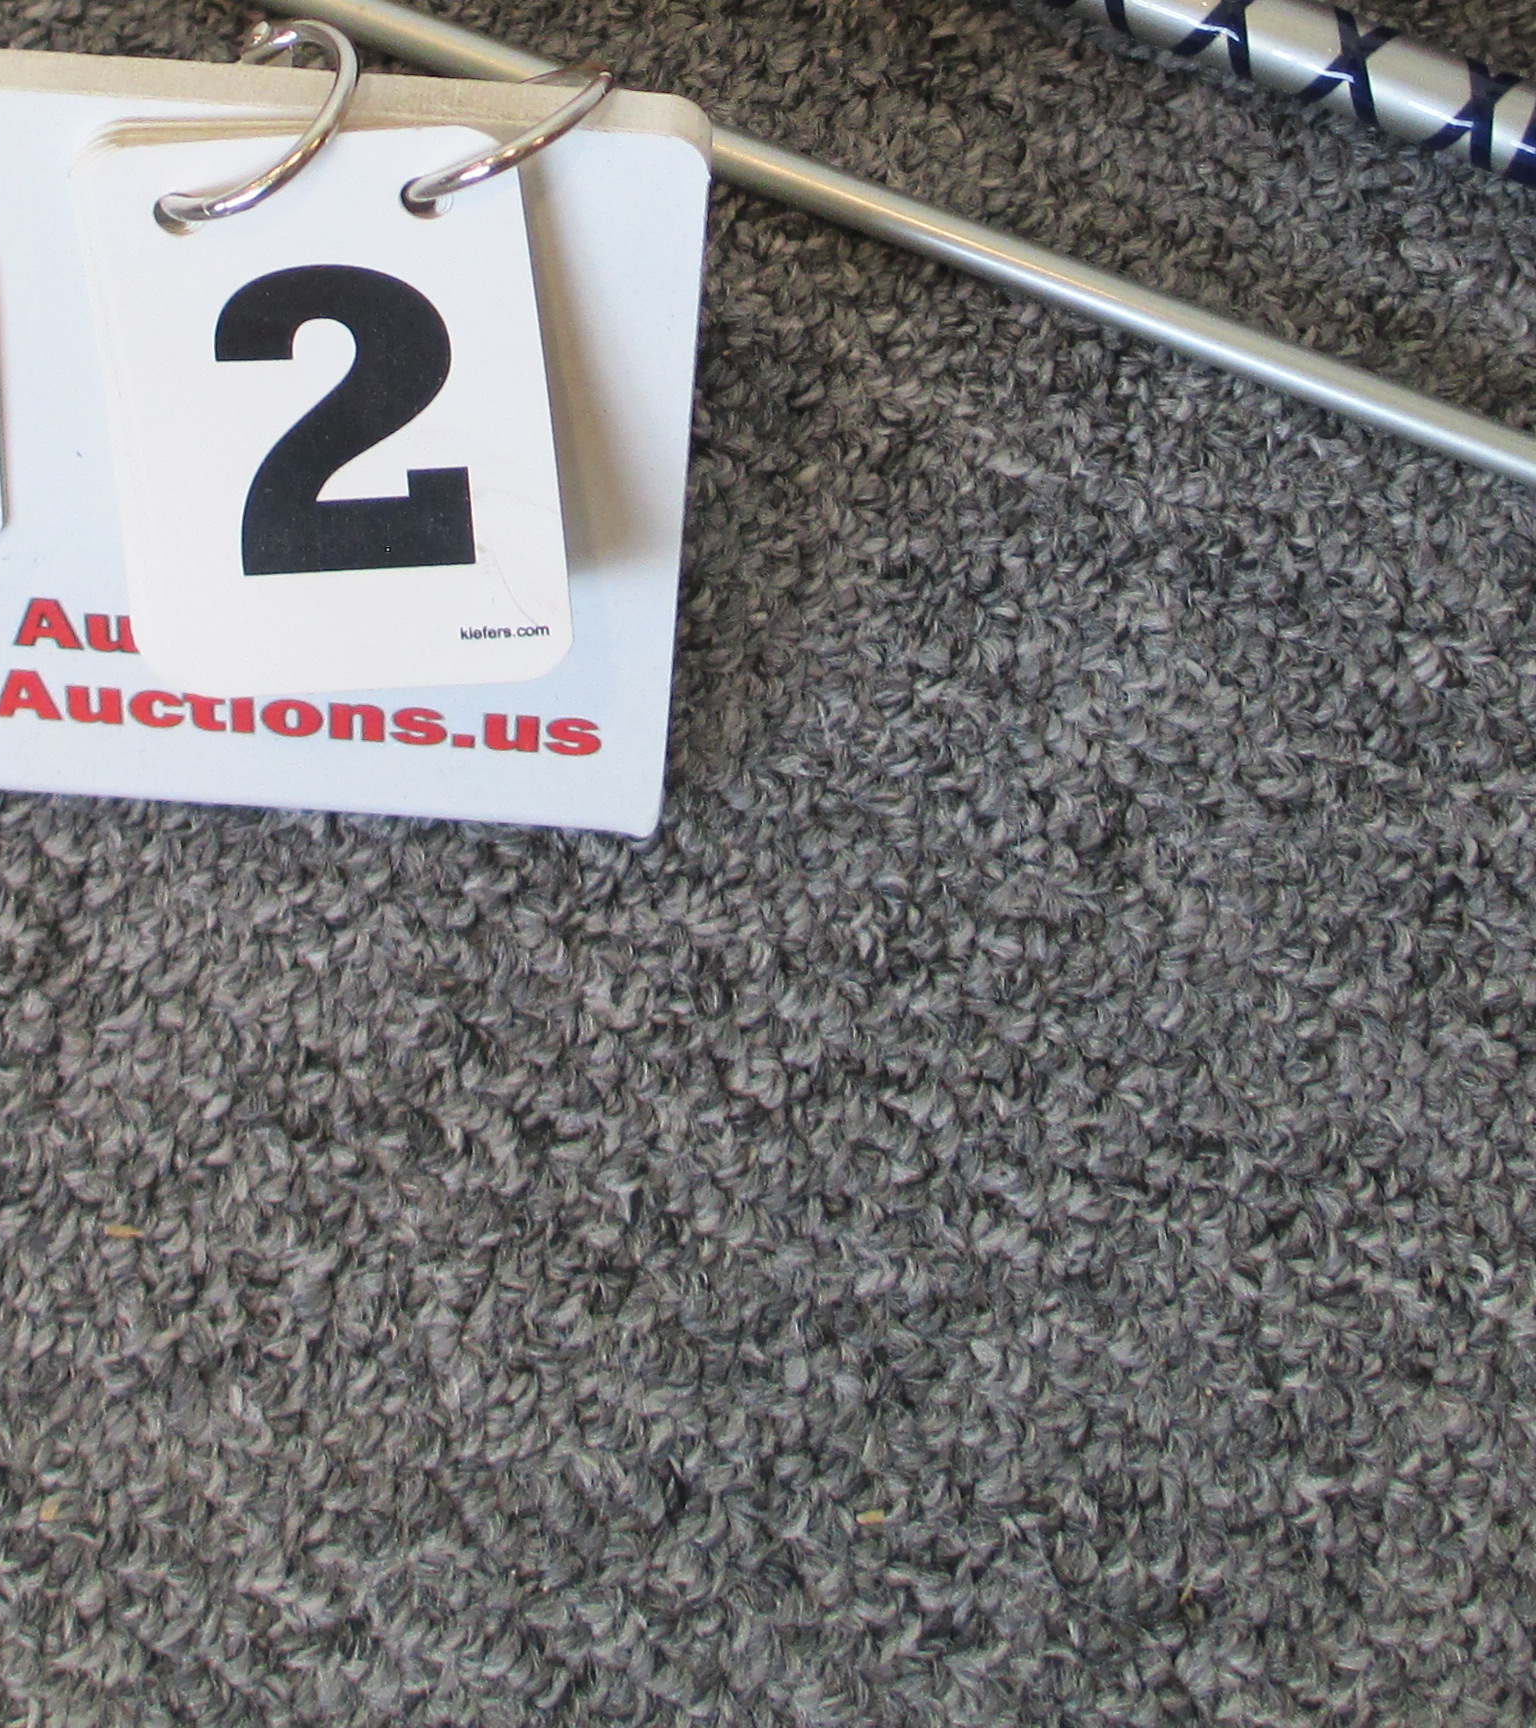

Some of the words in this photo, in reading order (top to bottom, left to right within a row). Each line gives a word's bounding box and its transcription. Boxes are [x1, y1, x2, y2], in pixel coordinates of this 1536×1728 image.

[214, 264, 476, 577] 2
[14, 596, 140, 654] Au
[460, 624, 550, 641] kiefers.com
